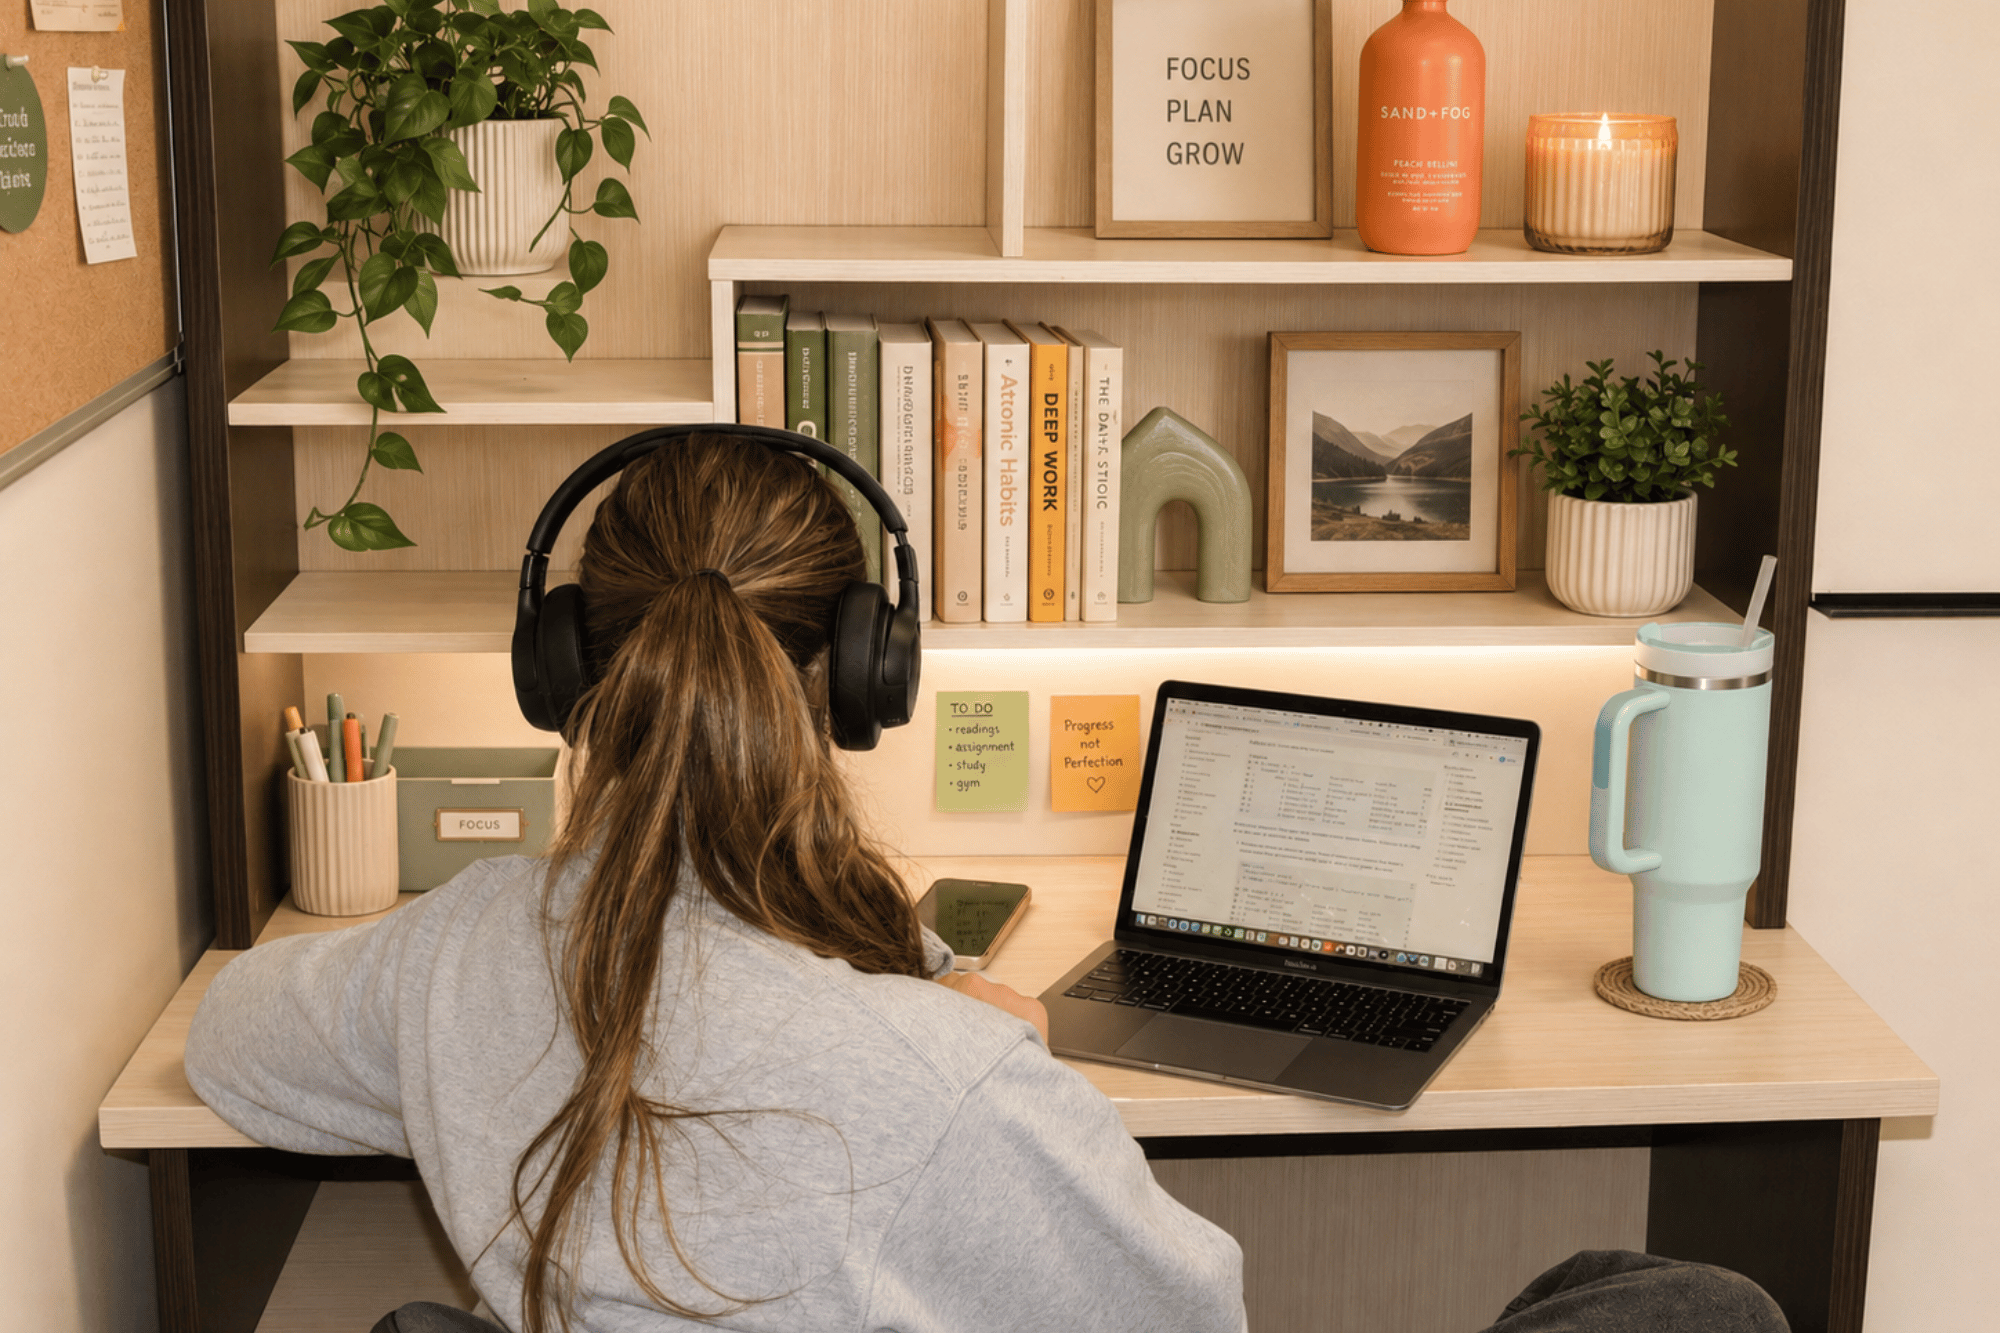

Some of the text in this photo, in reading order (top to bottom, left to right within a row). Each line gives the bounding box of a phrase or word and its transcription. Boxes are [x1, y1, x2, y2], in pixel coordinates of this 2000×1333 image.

[1166, 56, 1251, 81] FOCUS
[1166, 99, 1232, 123] PLAN
[1166, 141, 1245, 166] GROW
[1098, 377, 1110, 405] THE
[1043, 392, 1059, 444] DEEP
[1042, 450, 1058, 512] WORK
[1000, 458, 1018, 527] Habits
[950, 702, 993, 714] TO DO
[955, 723, 1000, 737] readings
[1064, 719, 1114, 735] Progress
[1079, 738, 1101, 750] not
[956, 759, 987, 774] study
[1064, 755, 1124, 770] Perfection
[956, 778, 981, 792] gym
[458, 819, 501, 830] FOCUS
